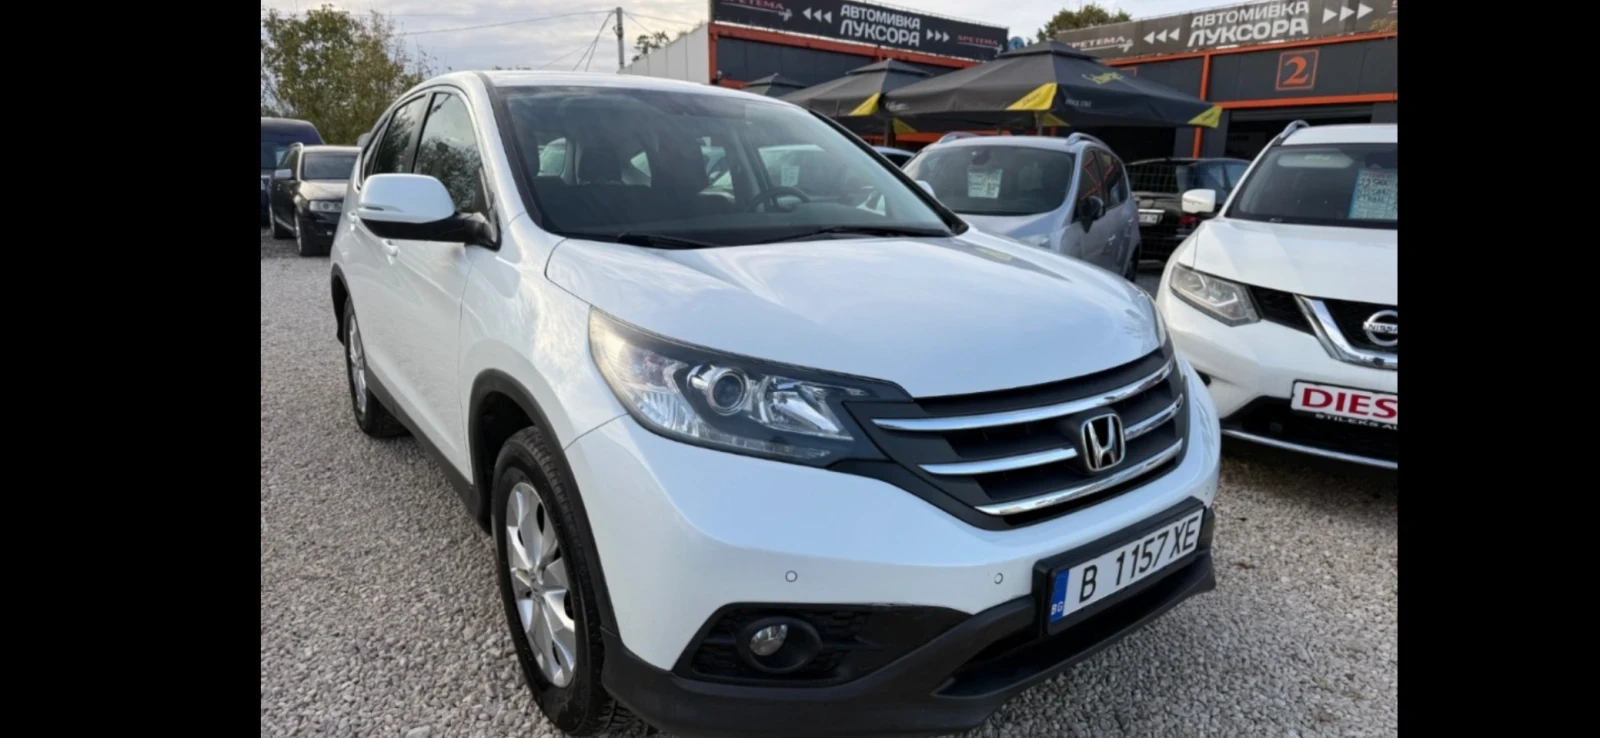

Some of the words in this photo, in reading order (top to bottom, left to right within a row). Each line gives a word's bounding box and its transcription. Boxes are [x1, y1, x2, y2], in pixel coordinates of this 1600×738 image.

[840, 4, 921, 31] АВТОМИВКА
[1191, 1, 1309, 28] АВТОМИВКА
[840, 19, 920, 48] ЛУКСОРА
[1187, 18, 1309, 47] ЛУКСОРА
[1282, 56, 1309, 85] 2
[1079, 564, 1098, 603] B
[1115, 530, 1170, 586] 1157
[1169, 515, 1199, 560] XE
[1050, 601, 1064, 615] BG
